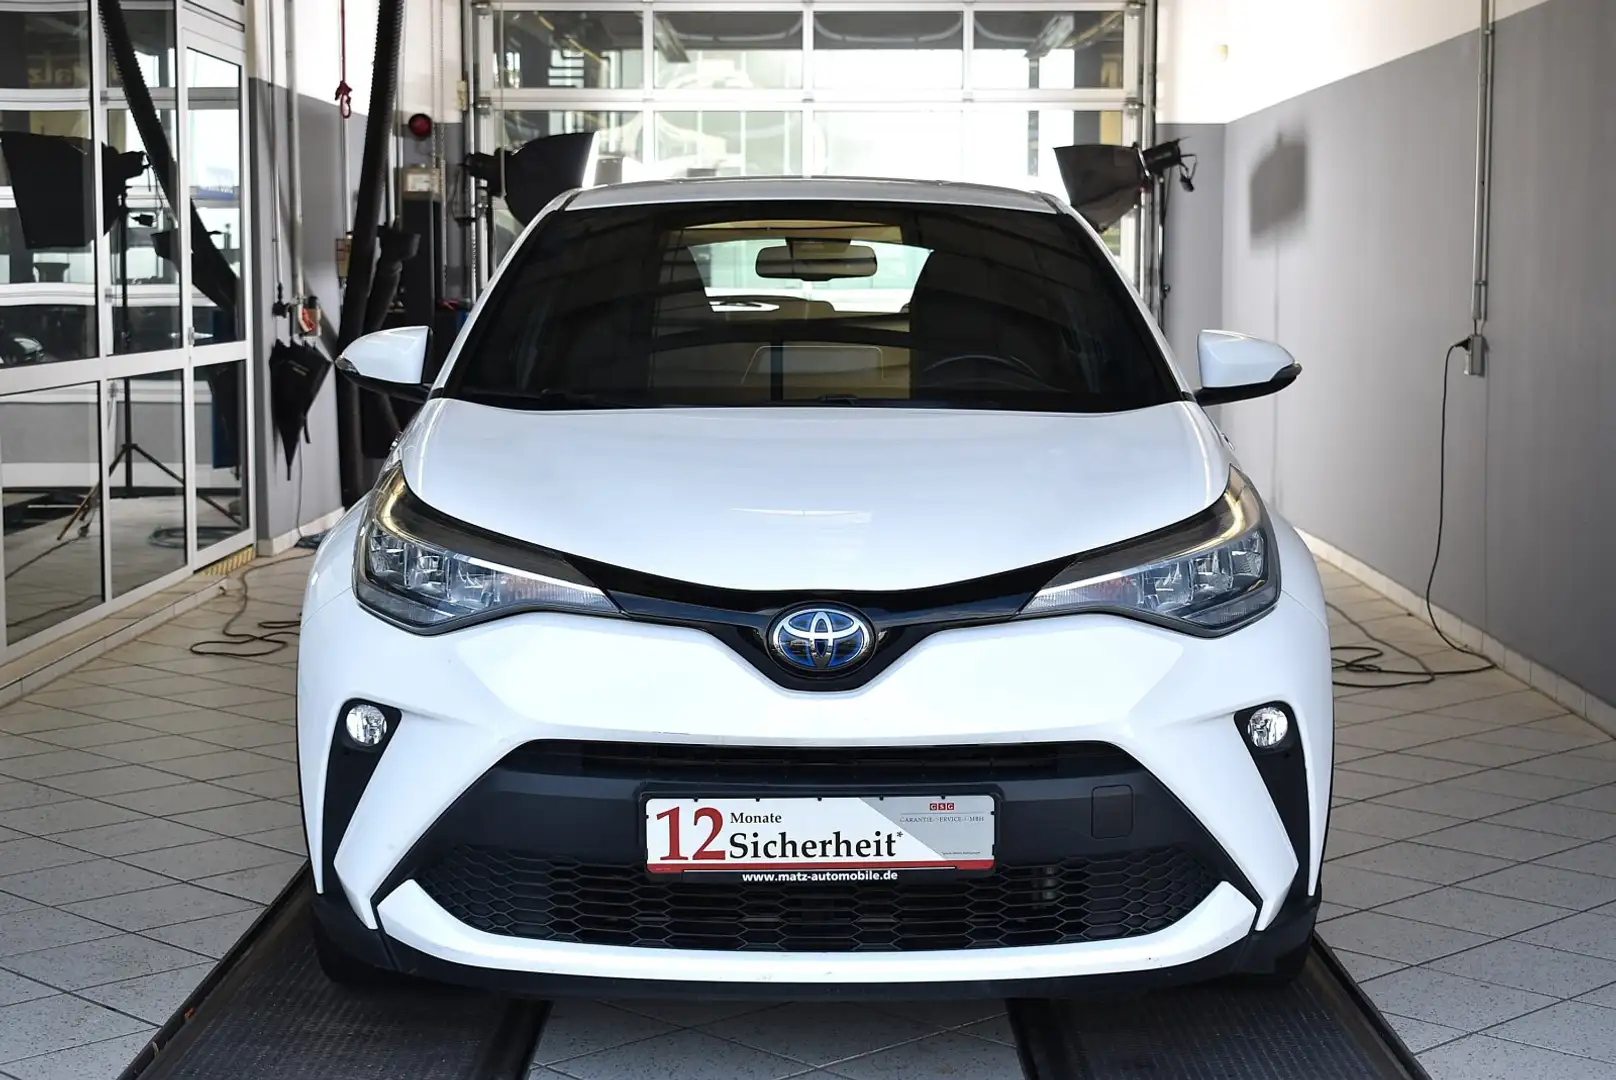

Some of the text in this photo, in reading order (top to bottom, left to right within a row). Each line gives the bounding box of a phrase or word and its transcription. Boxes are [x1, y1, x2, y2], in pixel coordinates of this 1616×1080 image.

[730, 812, 782, 824] Monate
[656, 806, 725, 861] 12
[742, 870, 898, 882] www.matz-automobile.de
